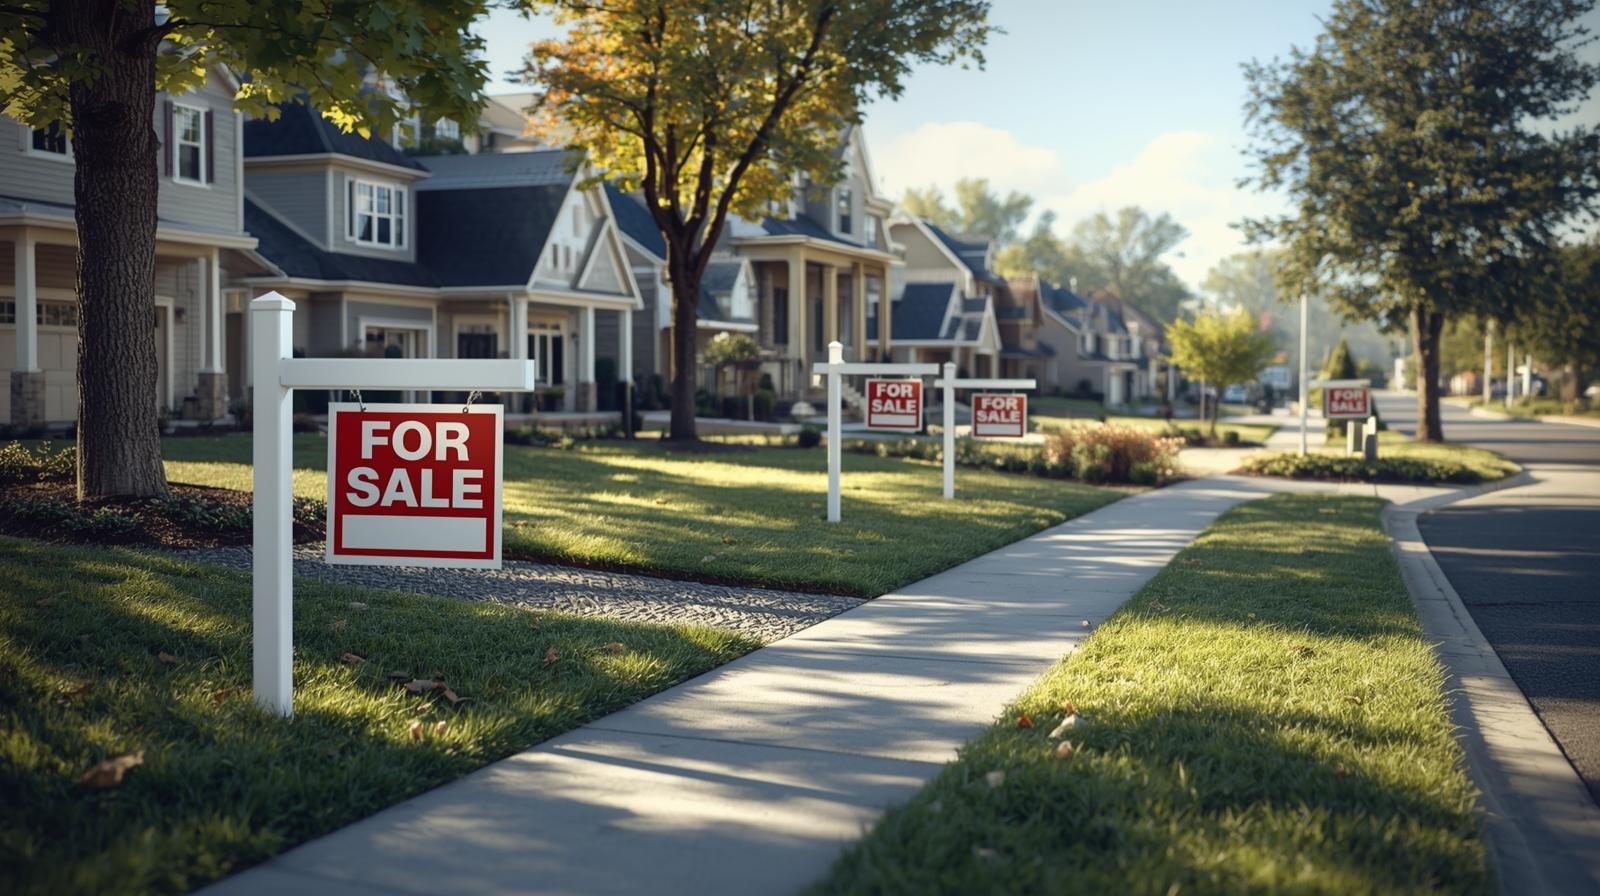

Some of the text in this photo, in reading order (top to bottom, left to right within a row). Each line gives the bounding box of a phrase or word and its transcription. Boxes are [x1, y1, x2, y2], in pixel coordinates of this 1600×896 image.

[876, 383, 913, 398] FOR
[871, 399, 917, 414] SALE
[981, 398, 1018, 410] FOR
[976, 410, 1021, 422] SALE
[361, 420, 470, 462] FOR
[346, 466, 484, 509] SALE
